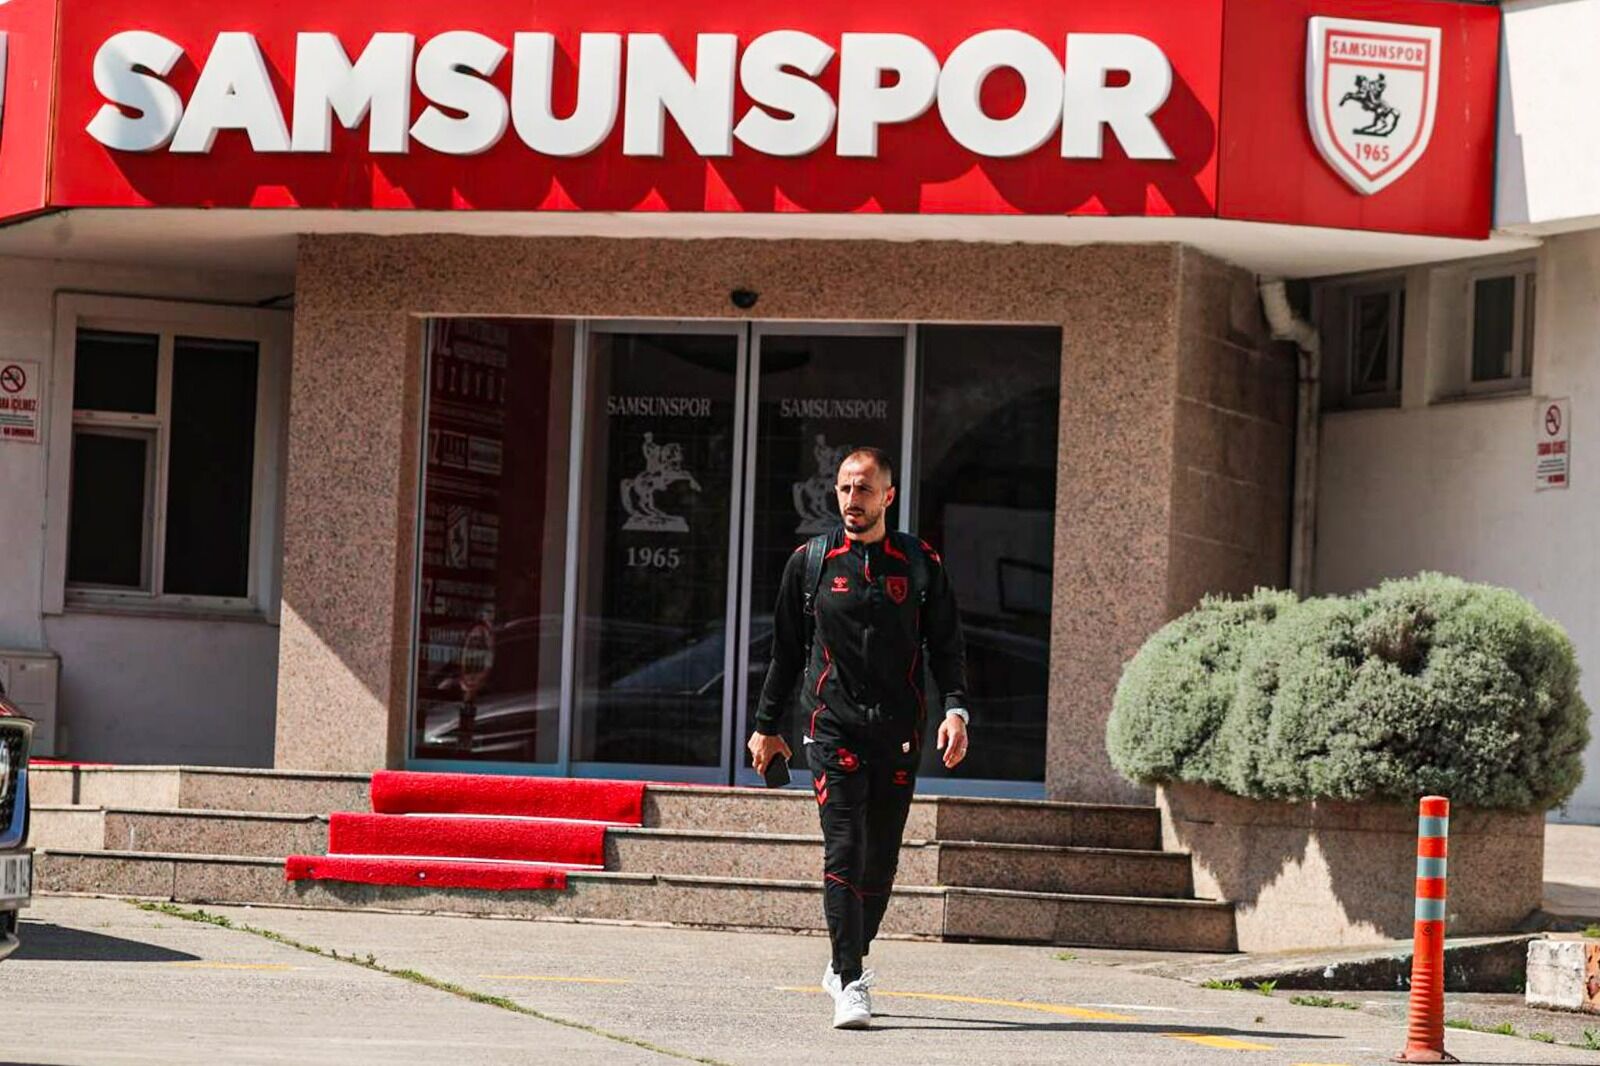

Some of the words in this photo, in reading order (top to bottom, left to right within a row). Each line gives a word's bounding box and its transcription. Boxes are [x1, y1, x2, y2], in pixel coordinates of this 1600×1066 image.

[1331, 39, 1425, 61] SAMSUNSPOR
[85, 28, 1175, 161] SAMSUNSPOR
[1354, 142, 1391, 162] 1965
[606, 395, 711, 418] SAMSUNSPOR
[779, 398, 888, 420] SAMSUNSPOR
[626, 546, 681, 569] 1965
